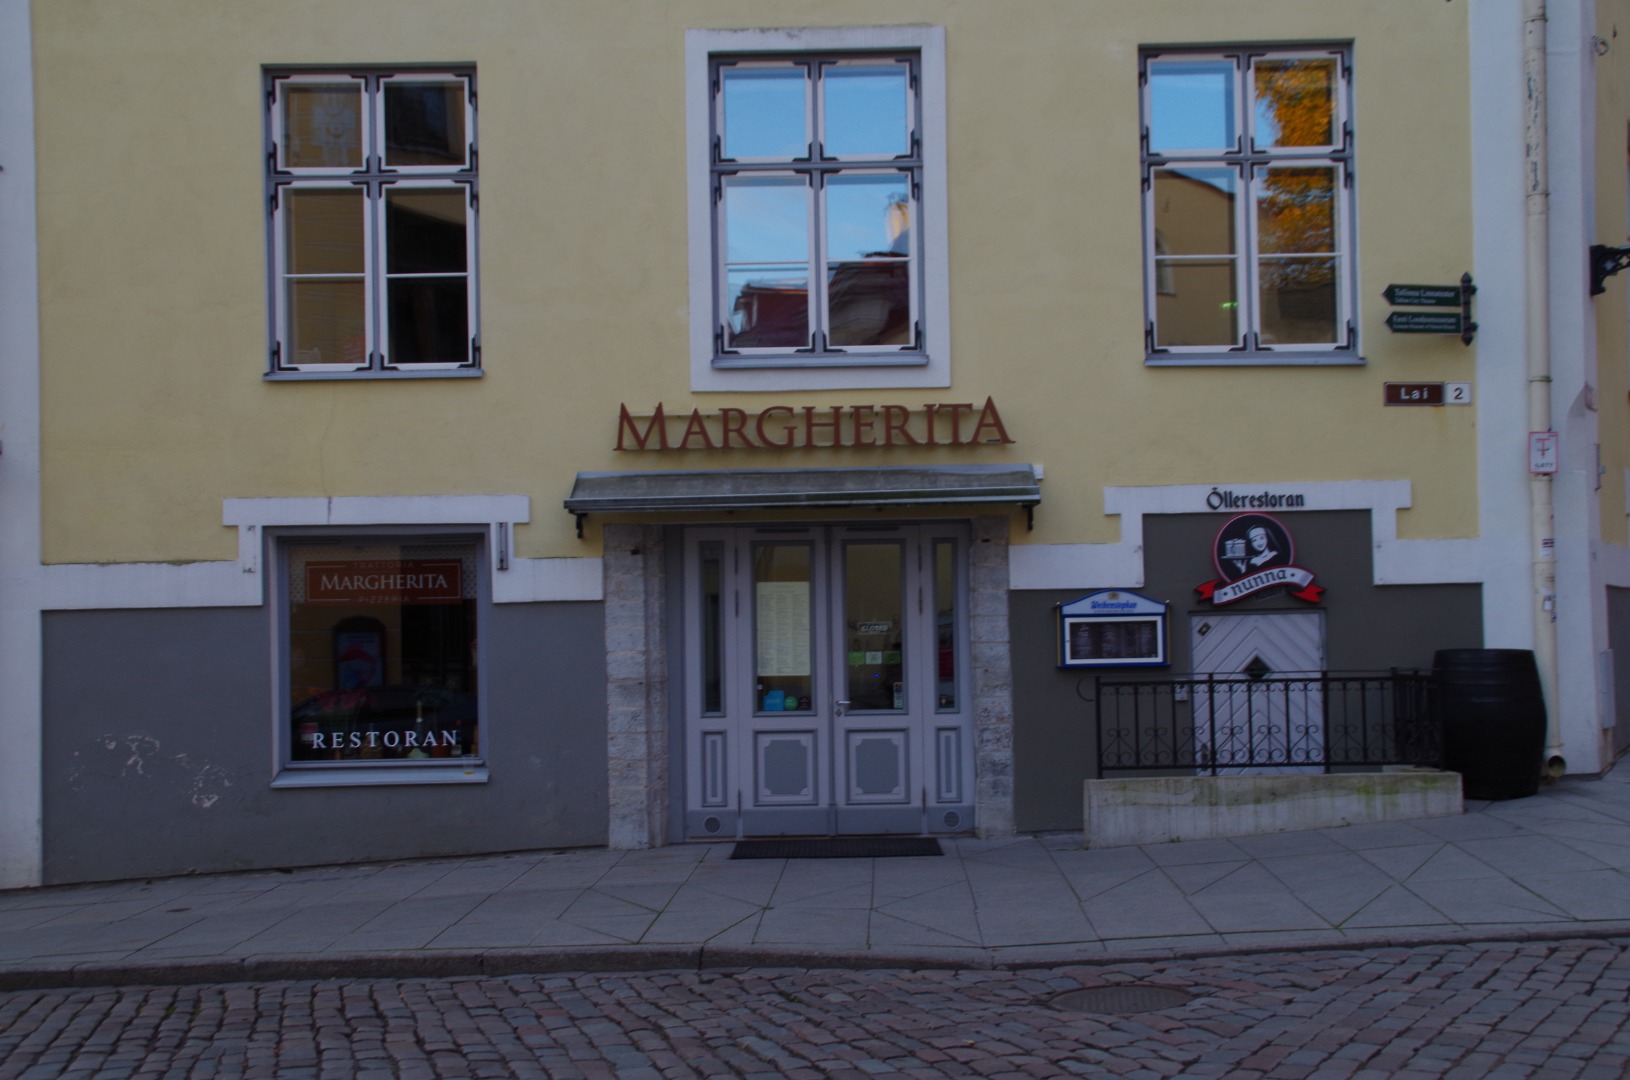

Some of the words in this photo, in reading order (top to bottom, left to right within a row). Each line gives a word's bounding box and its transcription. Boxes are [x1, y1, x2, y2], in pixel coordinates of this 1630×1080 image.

[1400, 387, 1429, 400] Lai
[1454, 387, 1464, 400] 2
[613, 395, 1016, 452] MARGHERITA
[1206, 487, 1304, 510] Öllerestoran
[353, 560, 415, 569] TRATTORIA
[320, 573, 448, 591] MARGHERITA
[1230, 569, 1288, 596] nunna
[358, 595, 411, 604] PIZZERIA
[312, 729, 457, 749] RESTORAN
